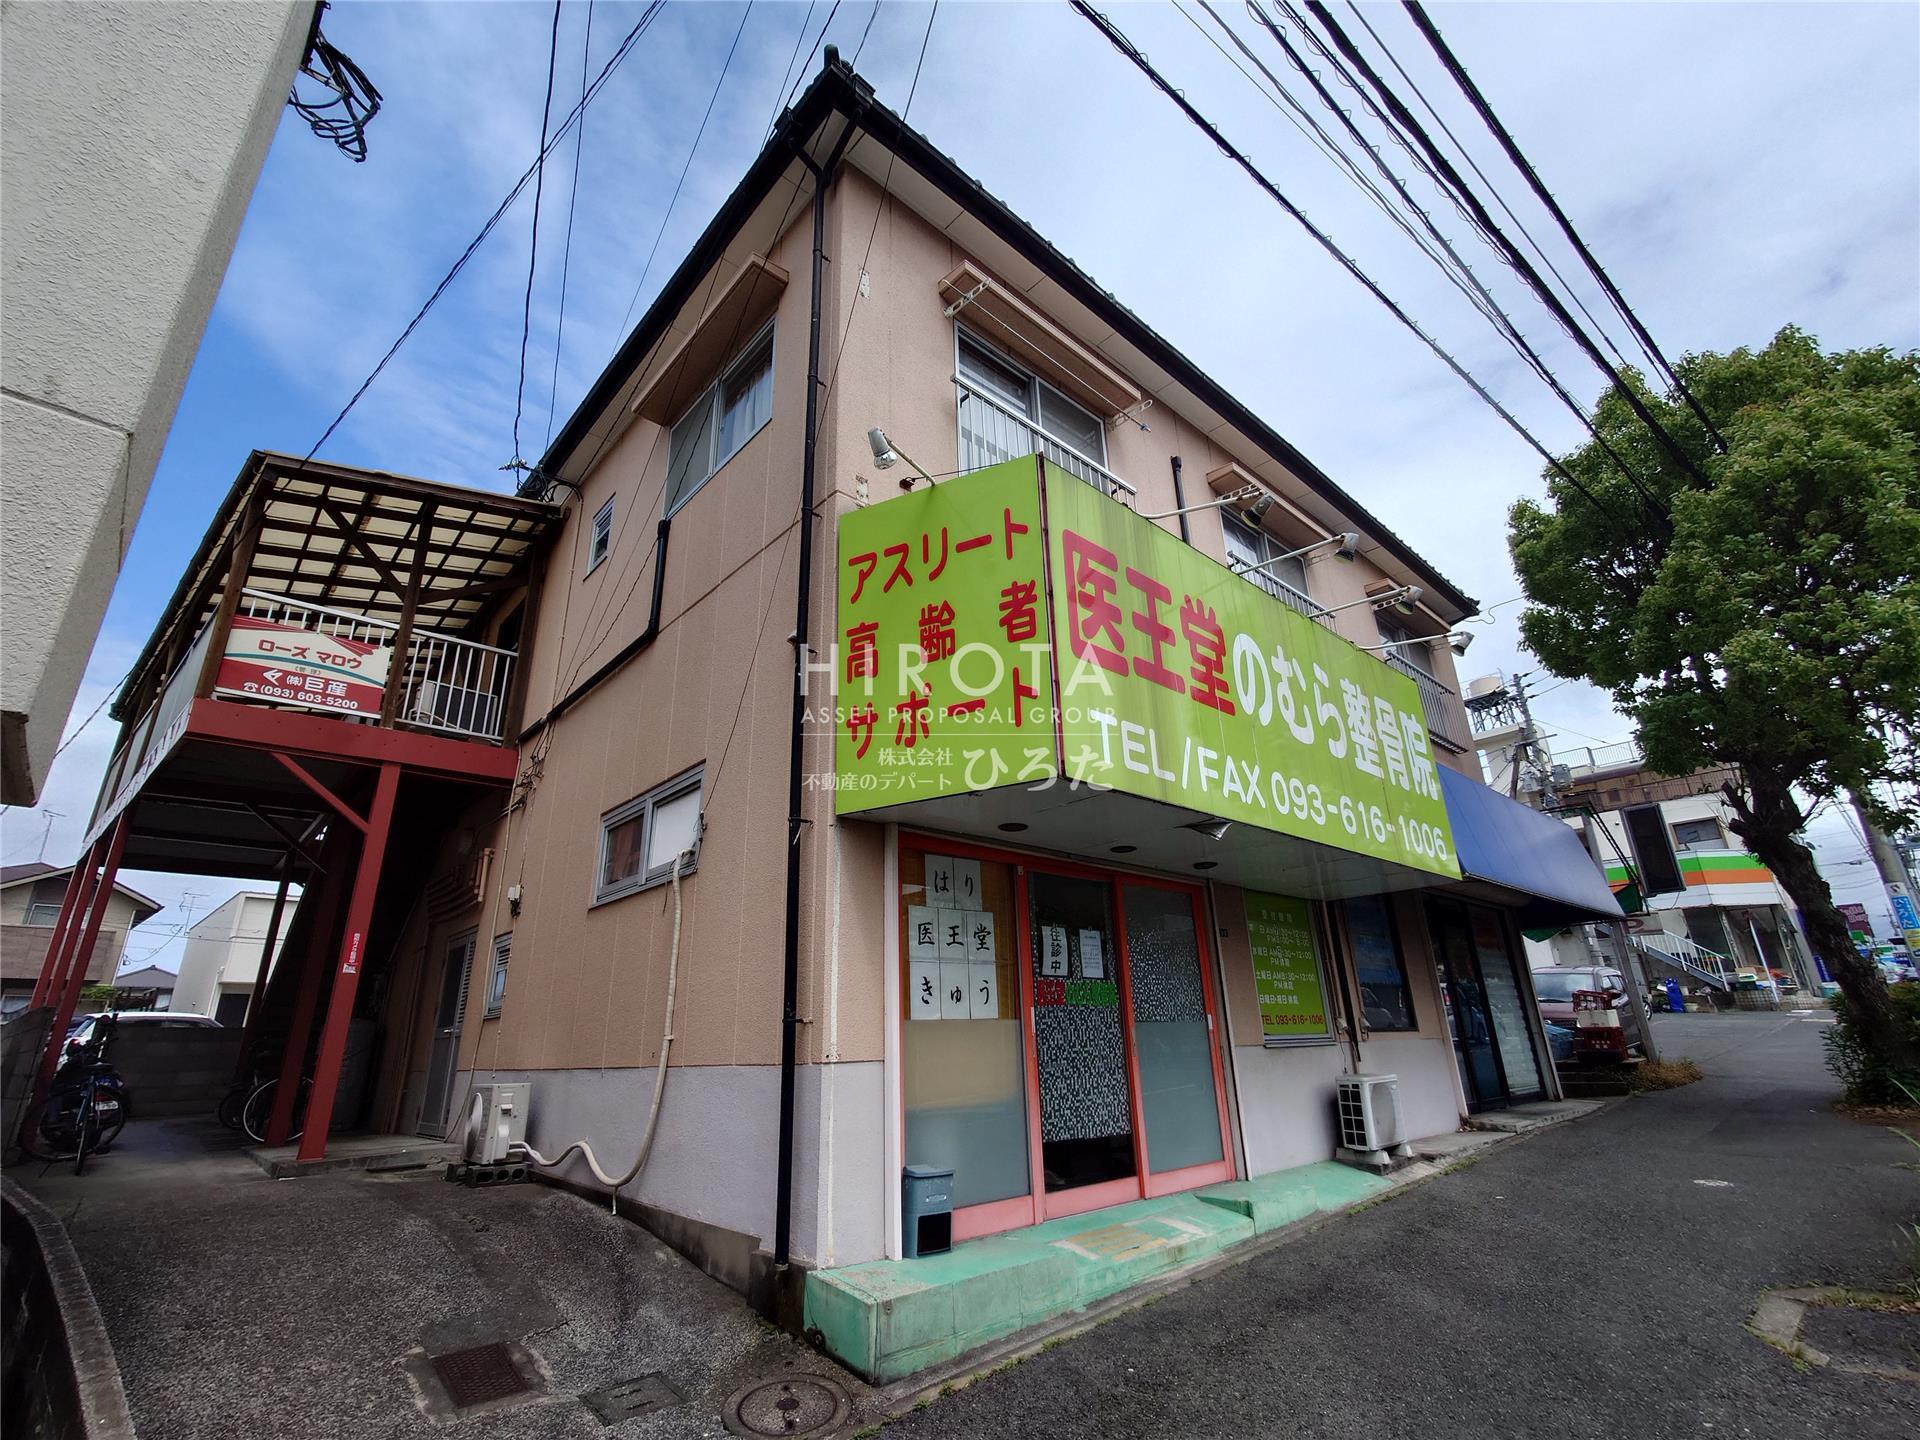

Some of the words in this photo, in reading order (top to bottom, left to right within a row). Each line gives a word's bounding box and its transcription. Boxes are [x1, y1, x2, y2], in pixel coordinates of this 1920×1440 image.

[847, 507, 1028, 604] アスリート
[847, 579, 1038, 684] 高齢者
[258, 639, 310, 659] ローズ
[316, 651, 362, 669] マロウ
[260, 684, 294, 699] (093)
[297, 691, 359, 709] 603-5200
[846, 666, 1039, 760] サポート
[1270, 771, 1448, 861] 093-616-1006
[933, 869, 975, 897] はり
[917, 921, 992, 952] 医王堂
[1050, 926, 1063, 973] 往診中
[920, 975, 991, 1005] きゅう
[1262, 1014, 1274, 1026] TEL
